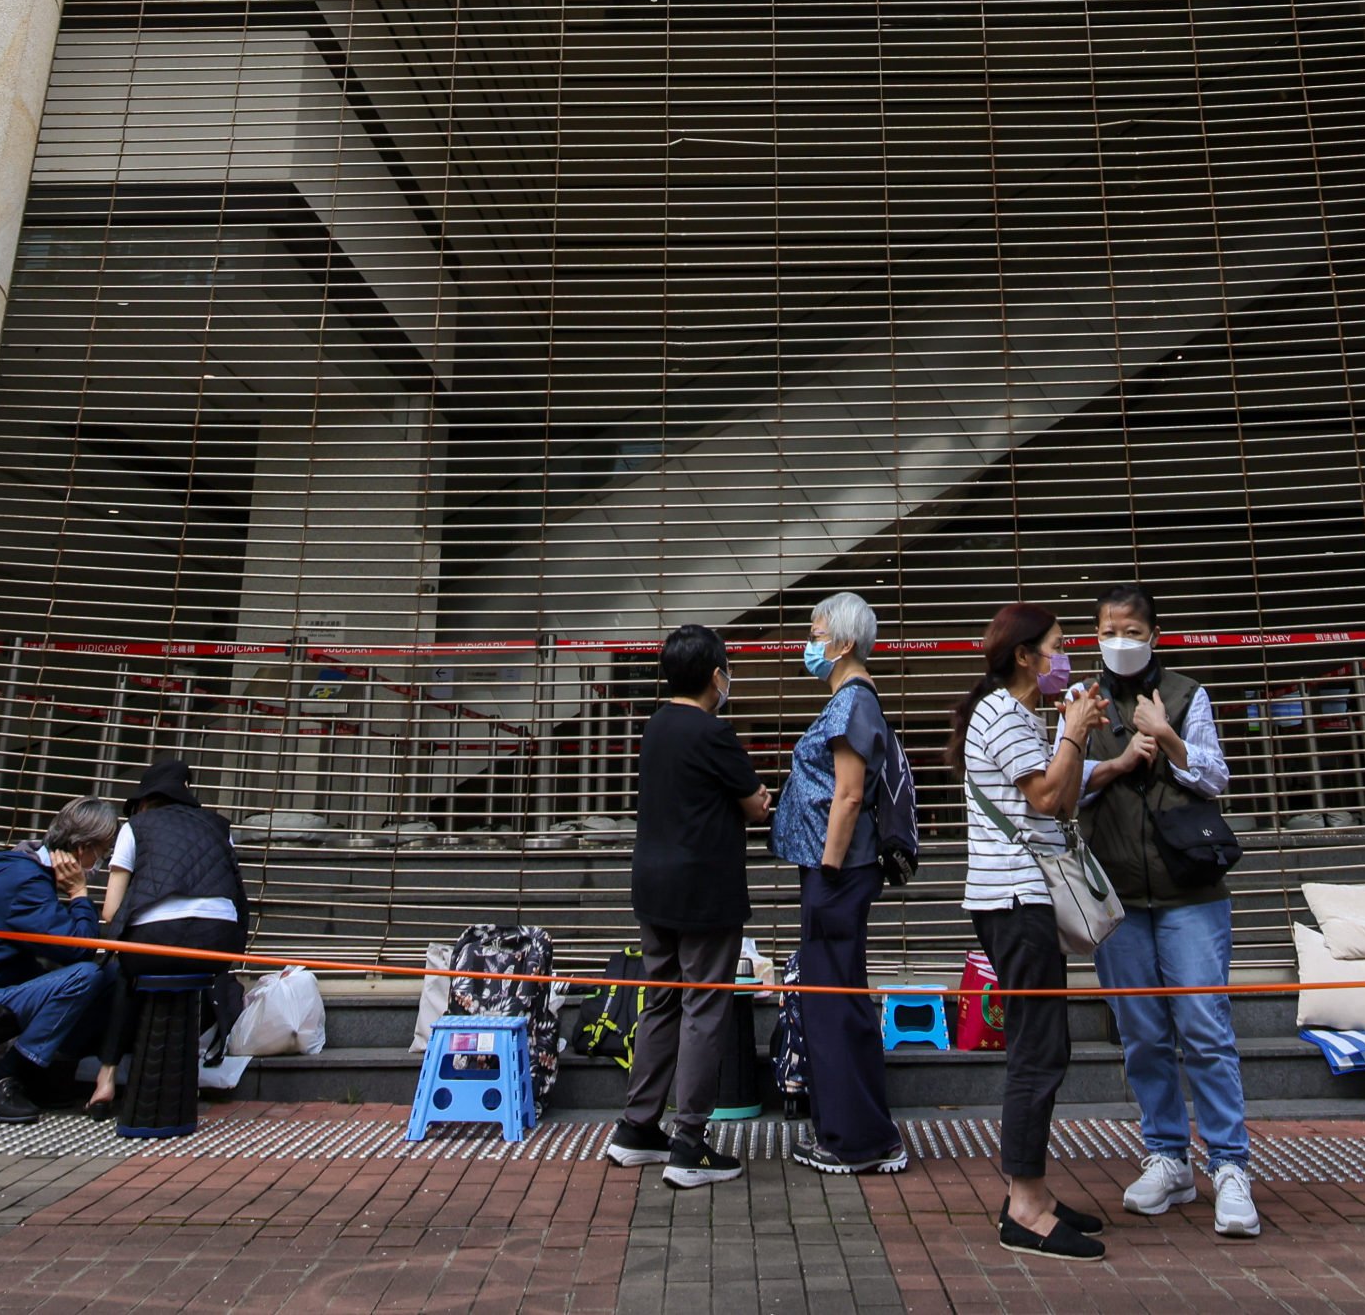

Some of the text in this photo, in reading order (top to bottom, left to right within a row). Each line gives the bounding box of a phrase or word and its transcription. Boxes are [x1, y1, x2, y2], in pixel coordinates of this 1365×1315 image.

[1183, 634, 1219, 645] 司法機構
[1240, 634, 1292, 644] JUDICIARY
[1314, 632, 1351, 642] 司法機構
[76, 643, 129, 654] JUDICIARY
[160, 644, 196, 654] 司法機構
[214, 645, 266, 654] JUDICIARY
[887, 640, 939, 650] JUDICIARY
